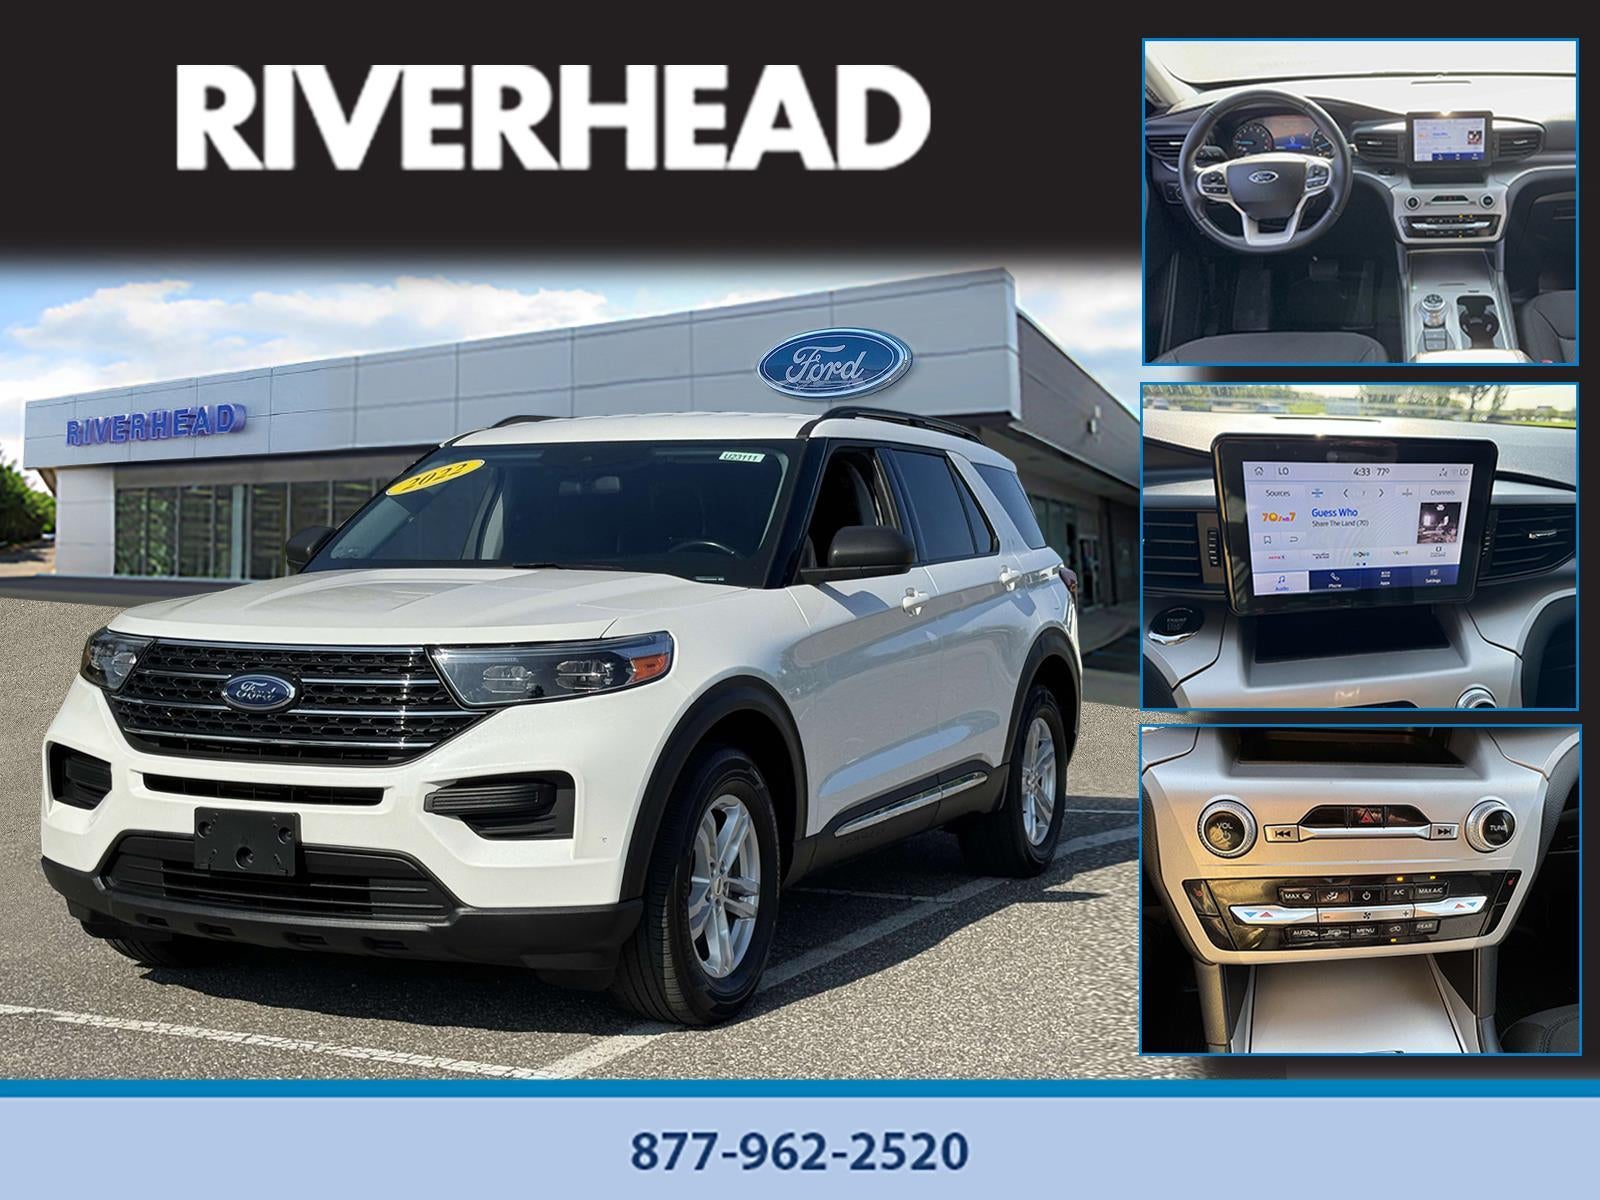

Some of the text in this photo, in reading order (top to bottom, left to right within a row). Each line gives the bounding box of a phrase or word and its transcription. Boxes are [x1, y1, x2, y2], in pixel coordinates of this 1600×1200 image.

[785, 344, 867, 384] Ford
[66, 403, 246, 447] RIVERHEAD
[1278, 467, 1290, 476] LO
[1353, 467, 1371, 476] 4:33
[401, 463, 468, 491] 2022
[1265, 489, 1291, 498] Sources
[1430, 488, 1456, 496] Channels
[1311, 508, 1358, 518] Guess Who
[1311, 519, 1329, 528] Share
[1329, 519, 1340, 527] The
[1340, 519, 1356, 527] Land
[236, 681, 277, 700] Ford
[1216, 822, 1234, 830] VOL
[1433, 886, 1443, 894] A/C
[1356, 928, 1376, 936] MENU
